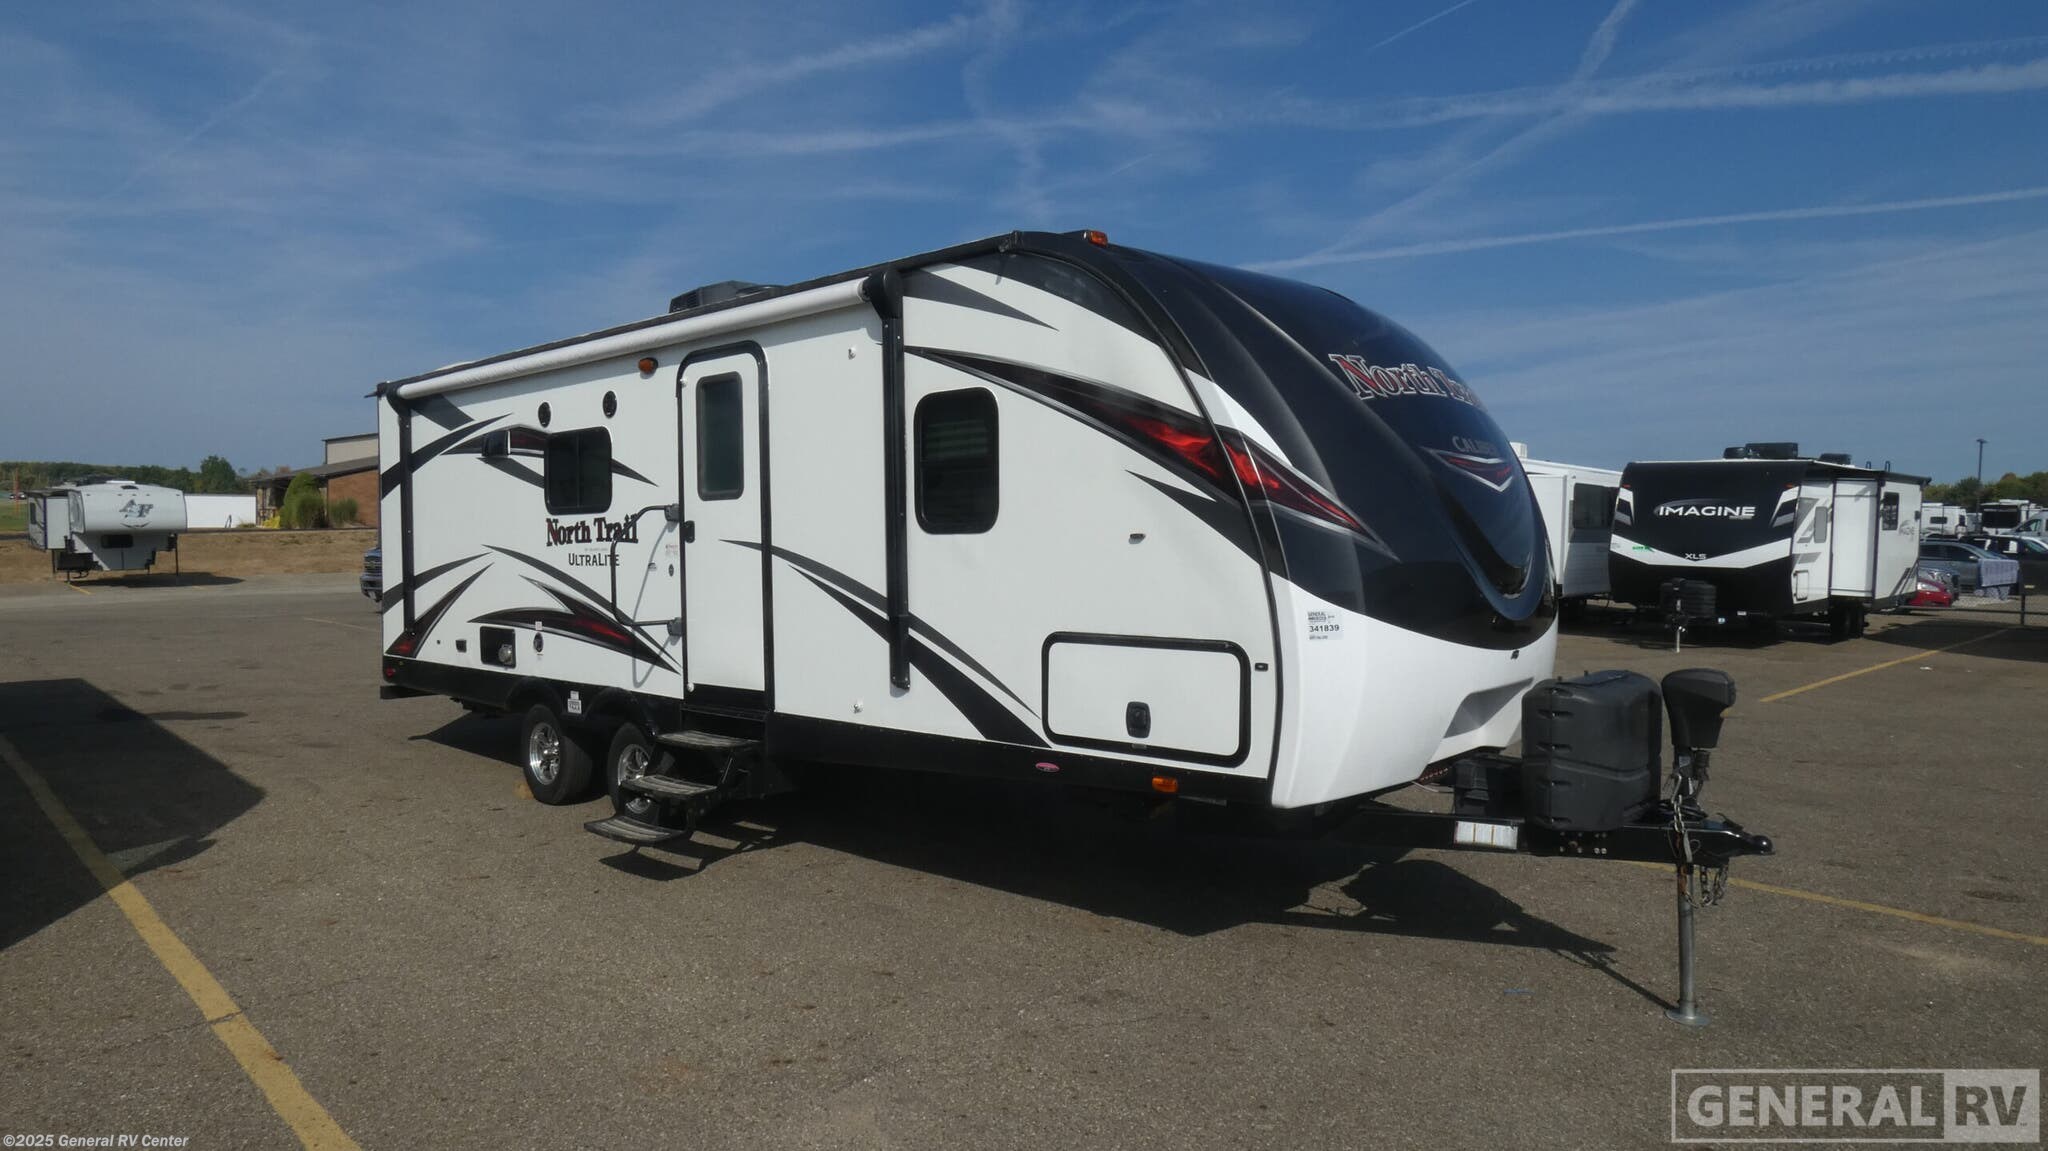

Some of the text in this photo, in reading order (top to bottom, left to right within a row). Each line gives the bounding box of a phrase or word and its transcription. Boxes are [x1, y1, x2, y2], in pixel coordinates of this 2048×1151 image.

[1328, 353, 1447, 400] North
[1658, 506, 1756, 517] IMAGINE
[546, 513, 639, 547] North Trail
[1309, 624, 1341, 633] 341839
